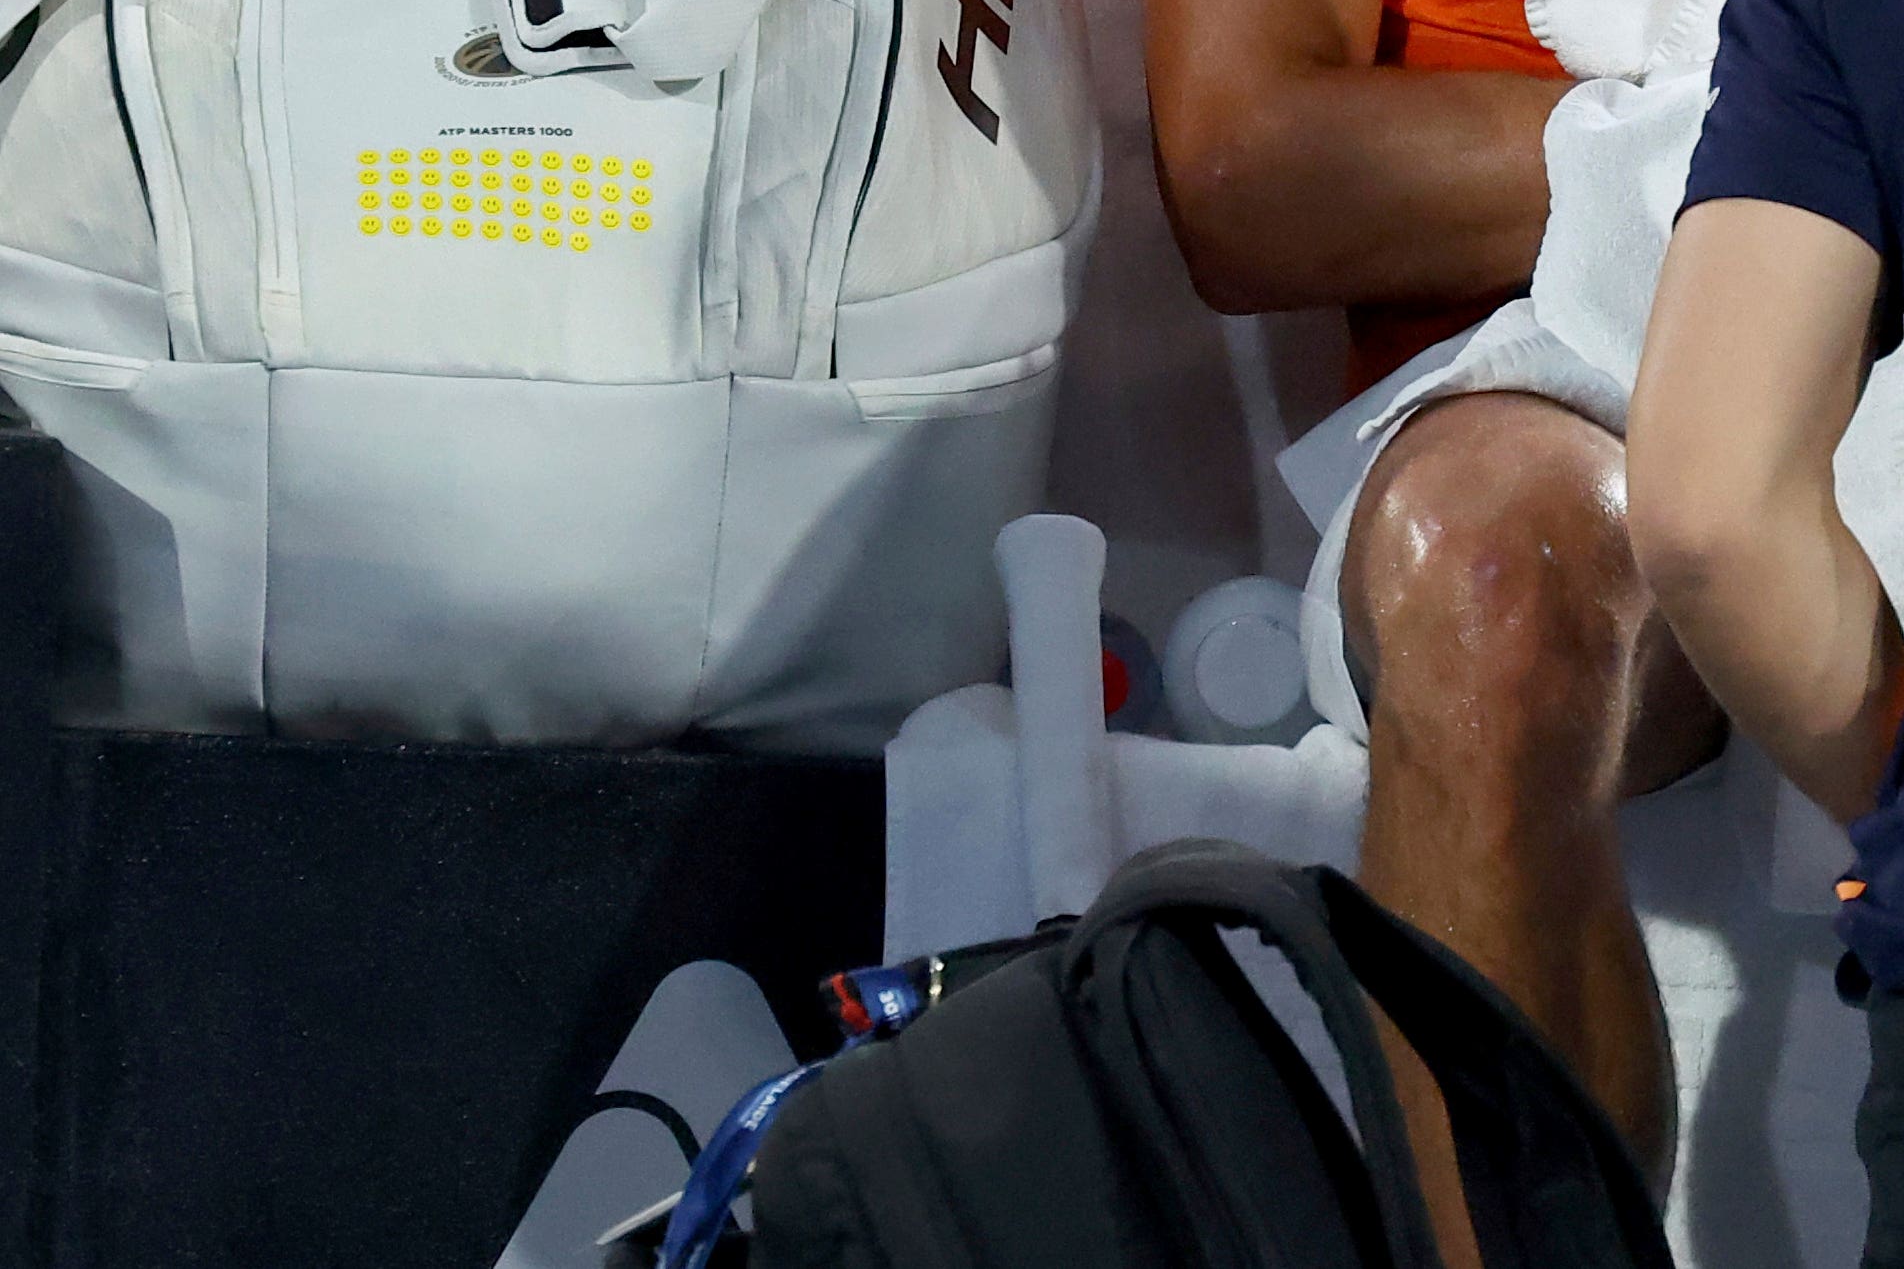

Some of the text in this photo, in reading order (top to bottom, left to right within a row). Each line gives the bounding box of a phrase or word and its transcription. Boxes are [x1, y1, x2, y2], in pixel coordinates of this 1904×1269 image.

[438, 126, 573, 137] ATP MASTERS 1000
